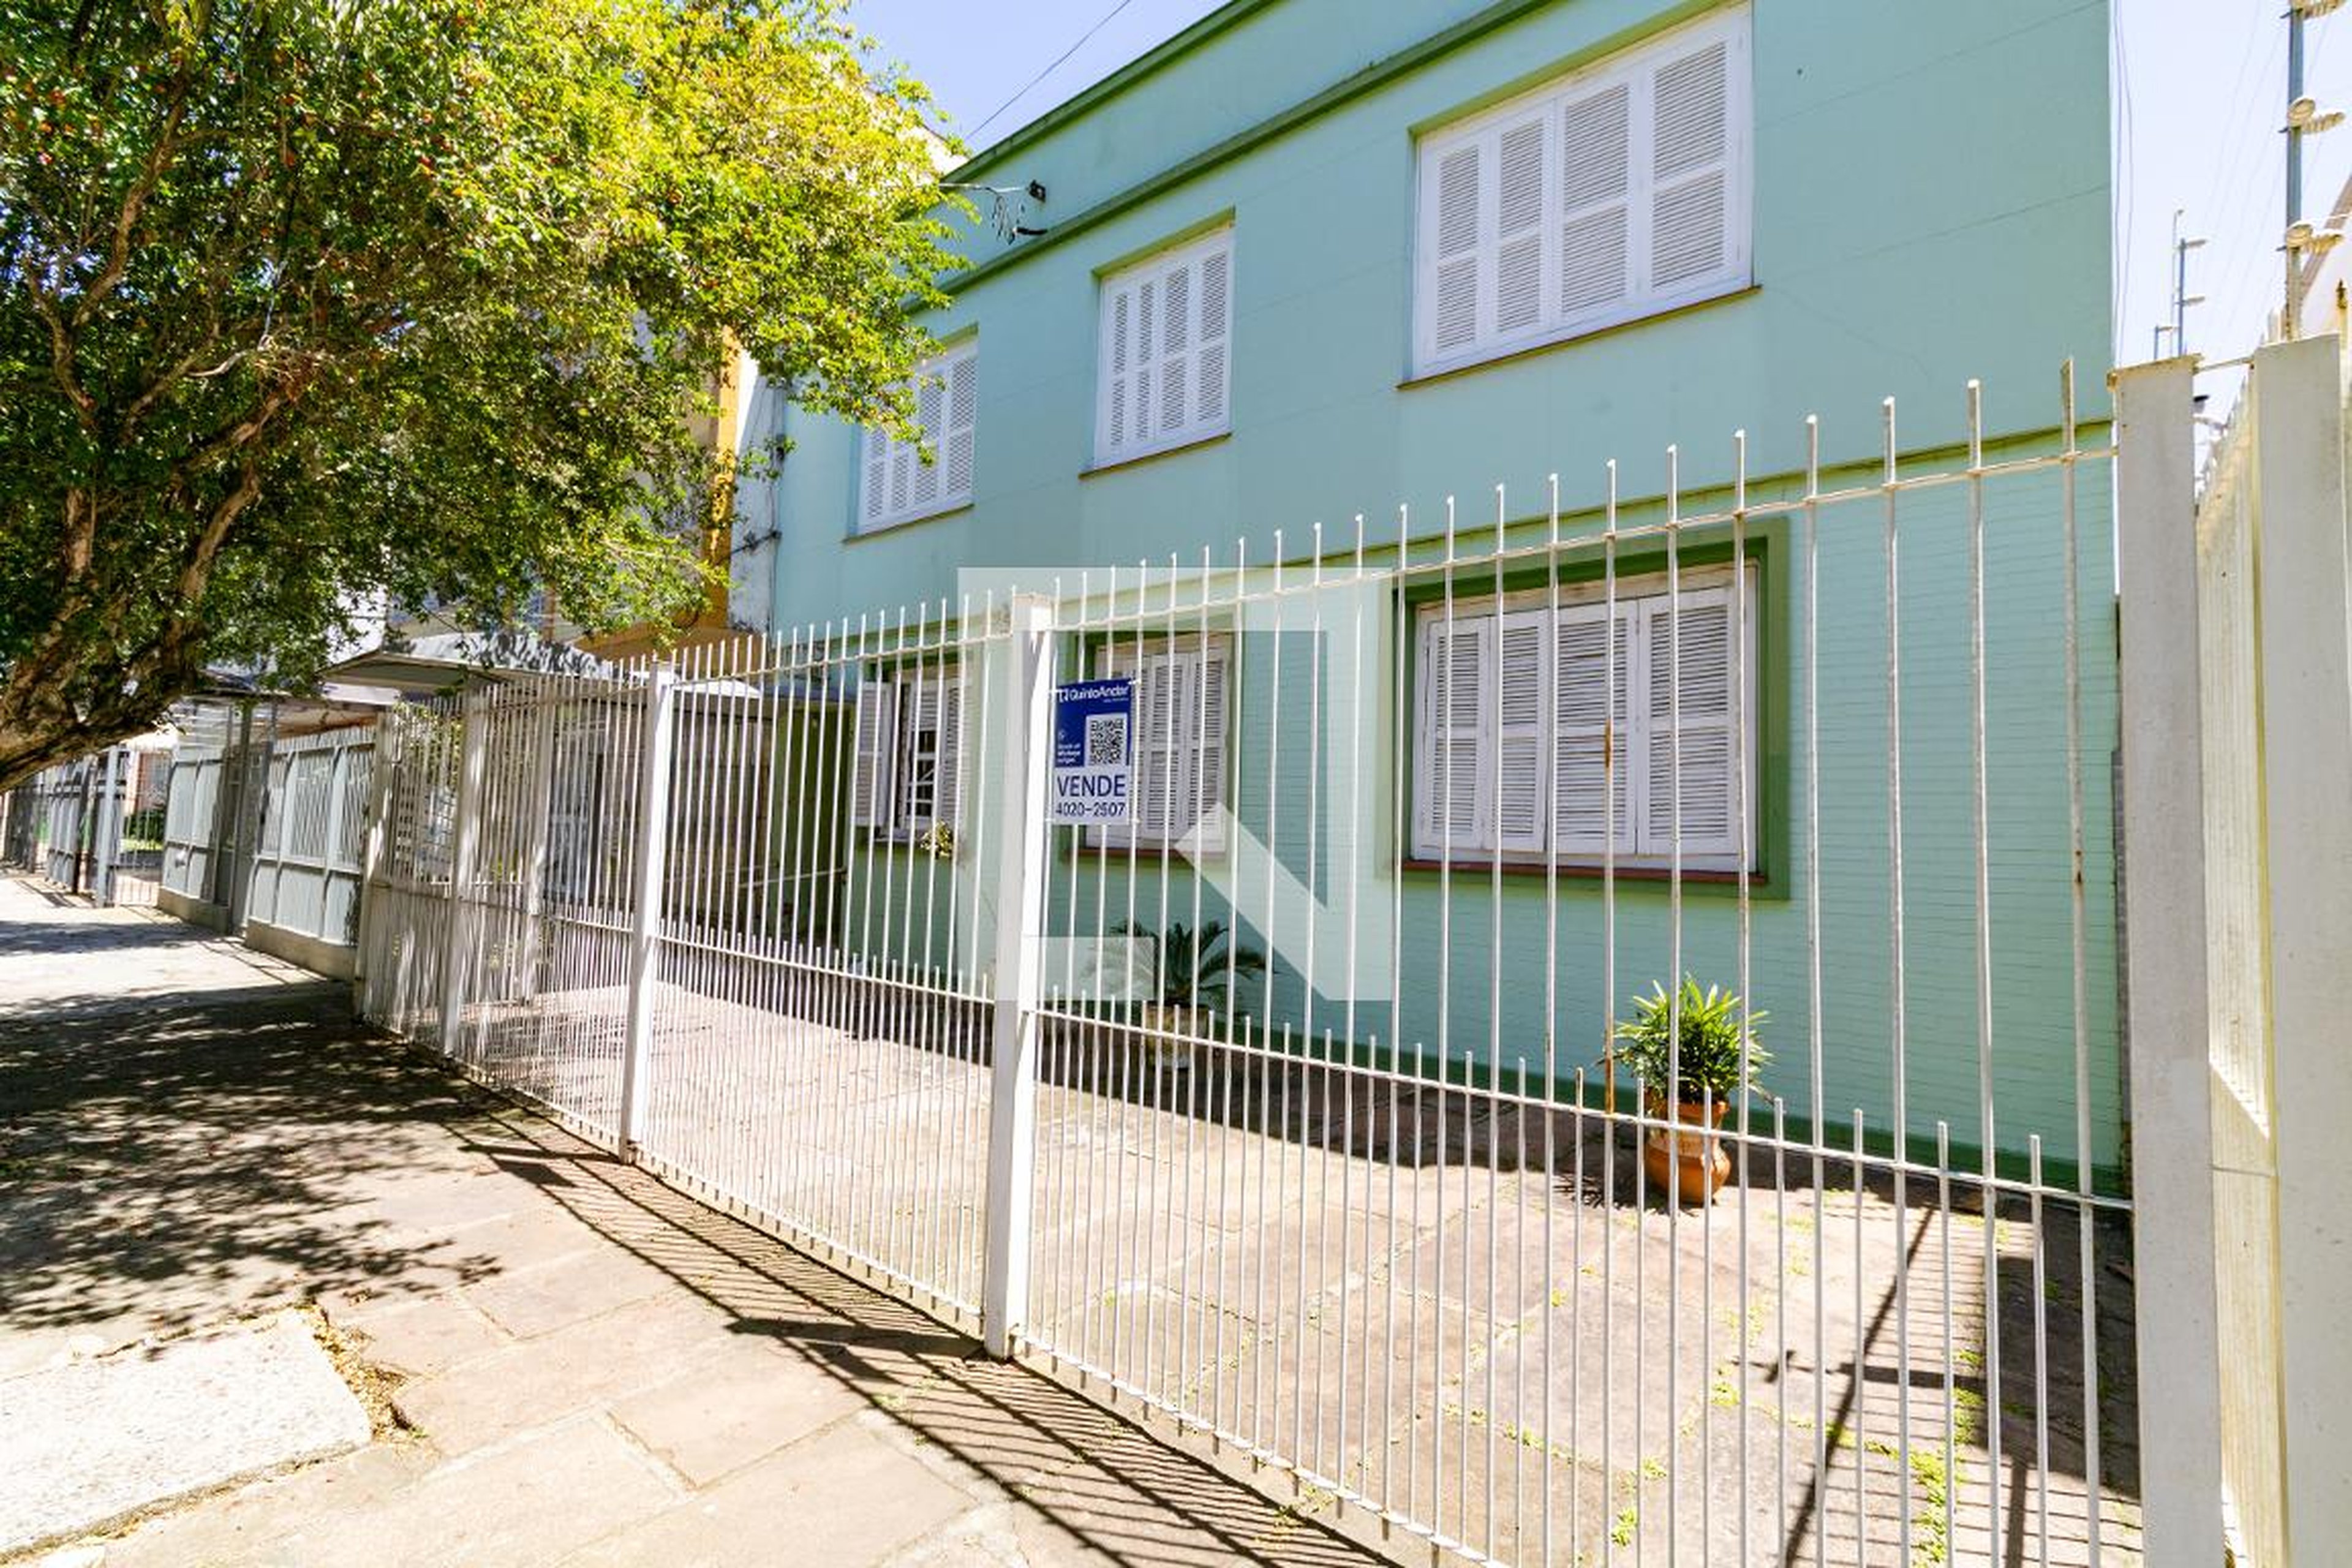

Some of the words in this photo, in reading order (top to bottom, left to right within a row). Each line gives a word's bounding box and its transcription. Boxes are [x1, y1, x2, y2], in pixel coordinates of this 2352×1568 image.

[1069, 685, 1129, 701] QuintoAndar
[1057, 775, 1125, 797] VENDE
[1055, 801, 1125, 816] 4020-2507
